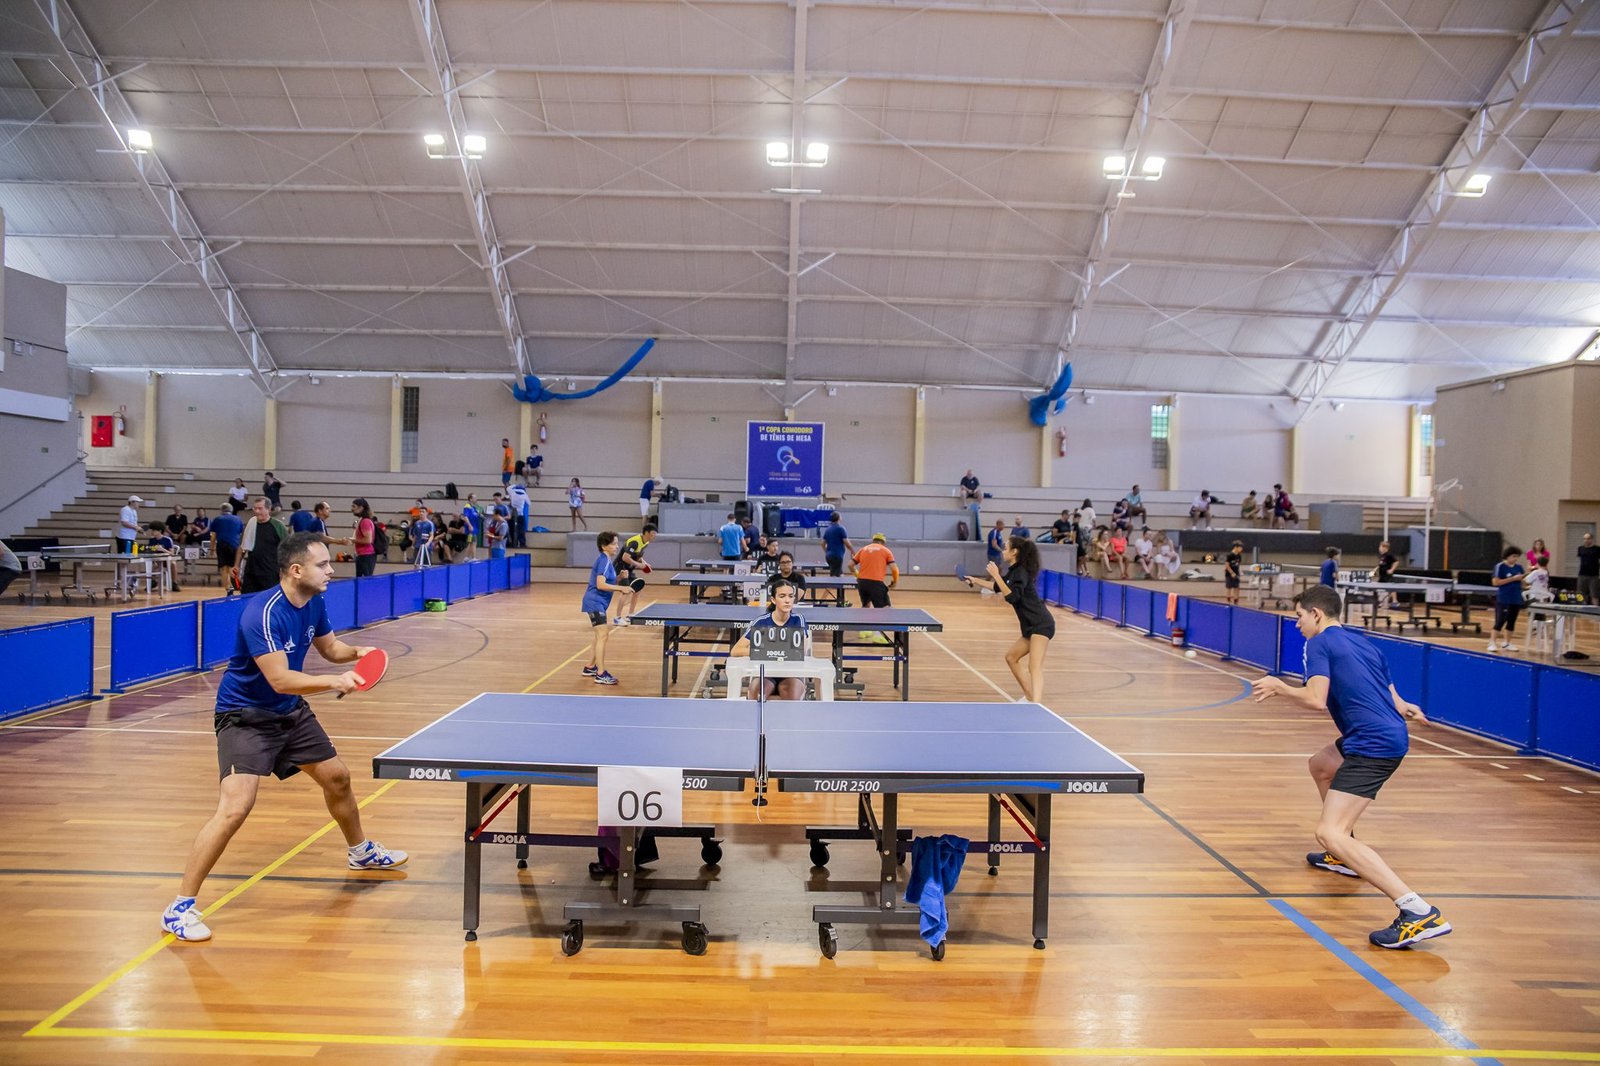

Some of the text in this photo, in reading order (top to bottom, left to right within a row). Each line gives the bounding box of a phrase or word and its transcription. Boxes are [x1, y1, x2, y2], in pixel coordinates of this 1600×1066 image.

[770, 433, 785, 441] TÊNIS
[748, 587, 760, 596] 08
[753, 627, 801, 648] 0 0 0 0
[409, 768, 452, 780] JOOLA
[814, 780, 1108, 793] TOUR 2500 JOOLA
[617, 790, 663, 821] 06
[492, 834, 527, 844] JOOLA
[989, 844, 1023, 853] JOOLA
